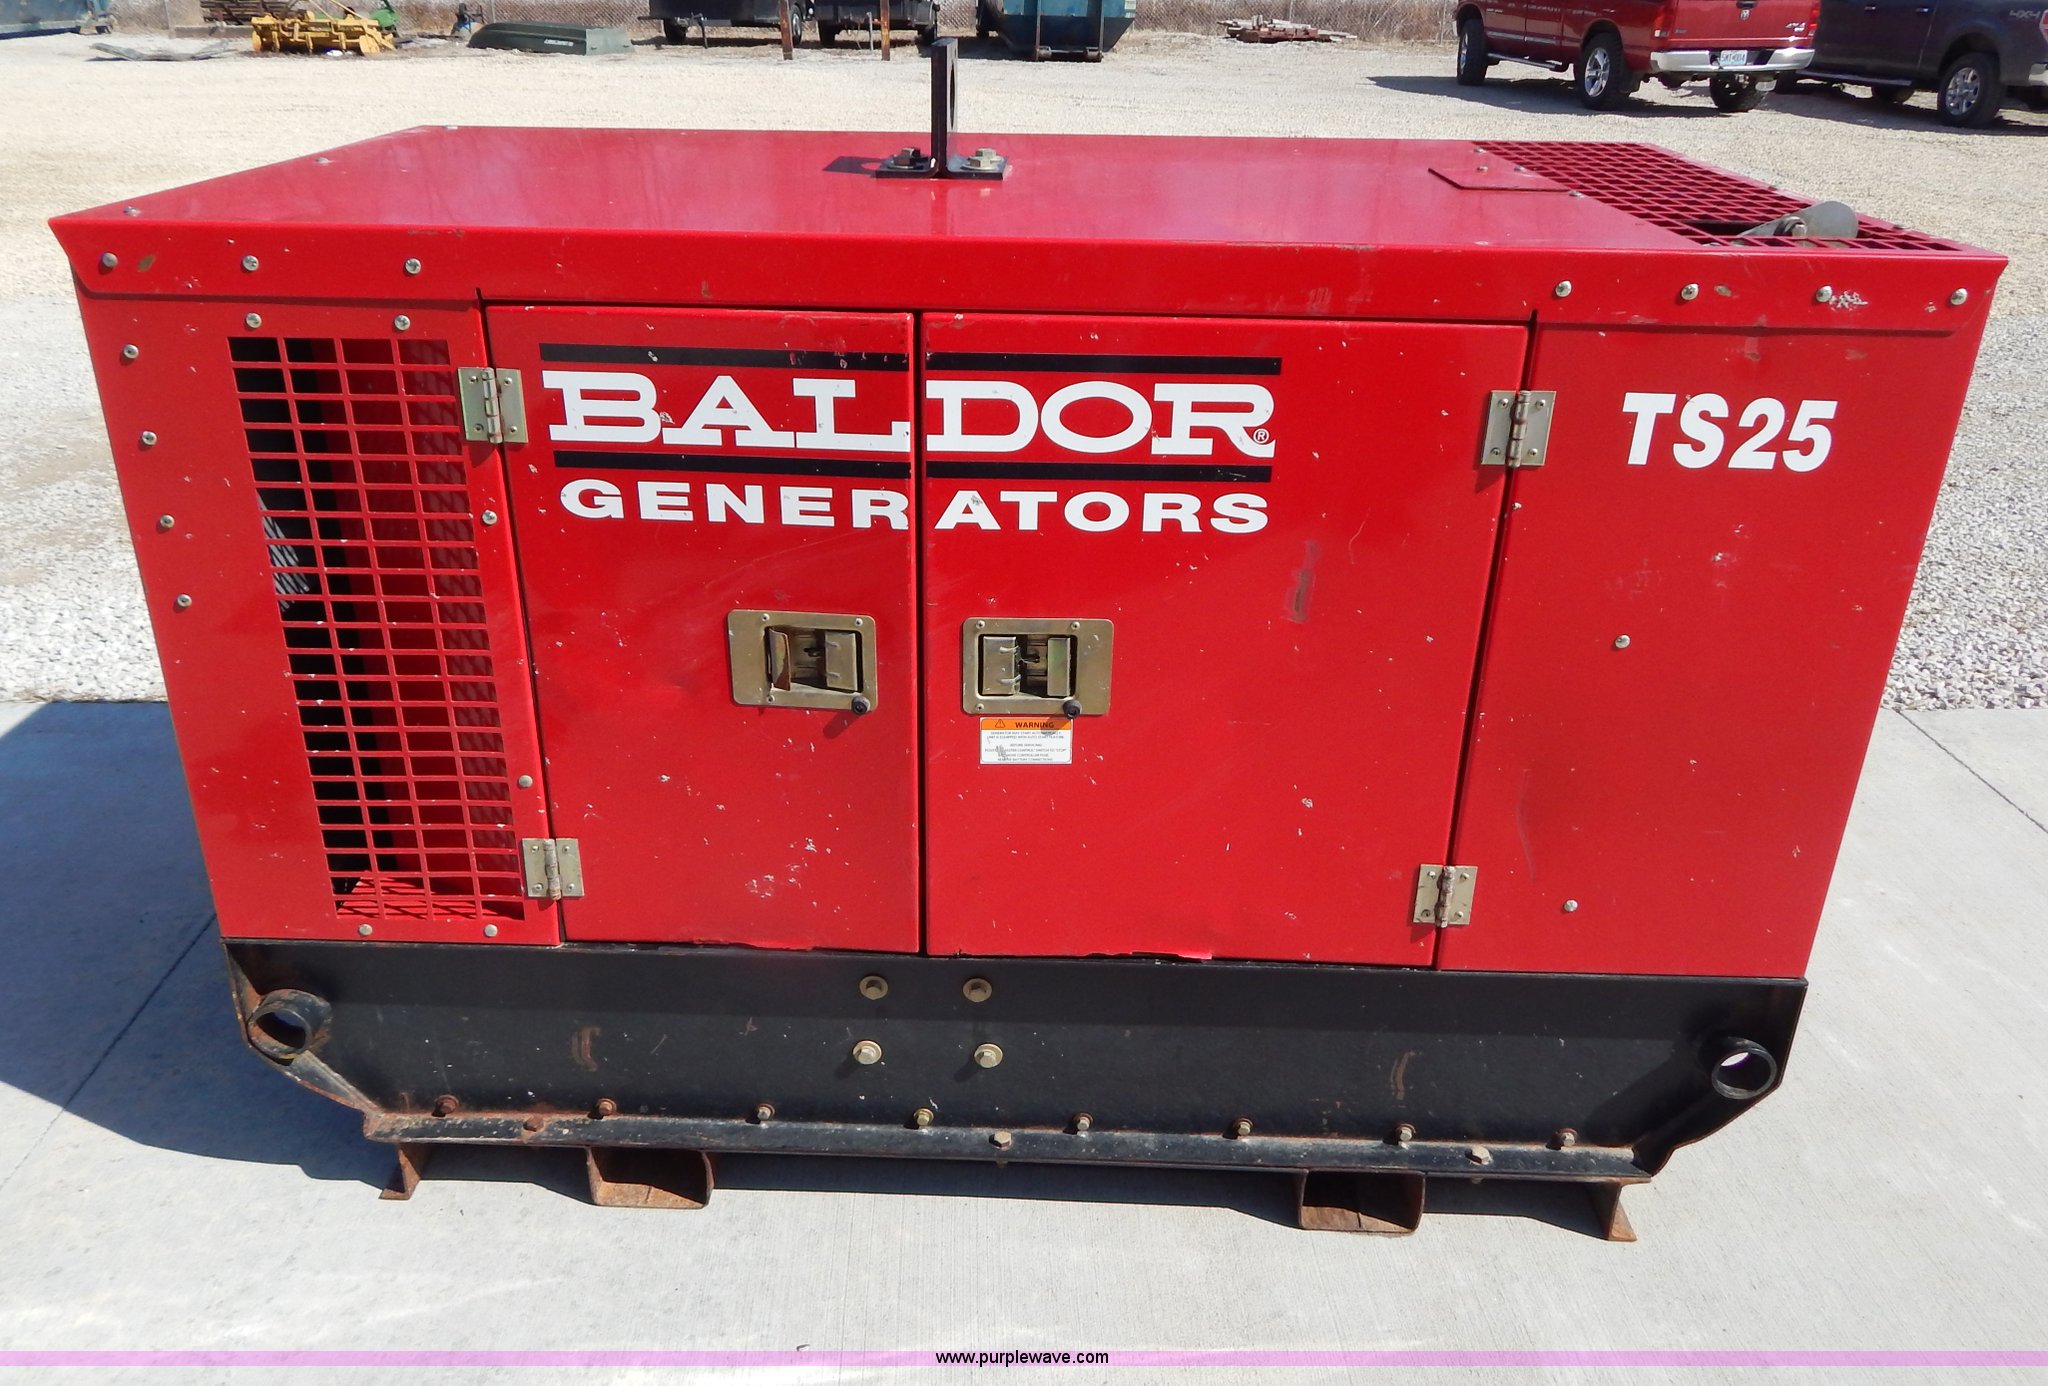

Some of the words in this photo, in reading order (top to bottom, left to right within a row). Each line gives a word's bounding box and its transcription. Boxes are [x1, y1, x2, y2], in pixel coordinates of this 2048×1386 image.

[542, 370, 1276, 458] BALDOR
[1622, 392, 1838, 473] TS25
[560, 478, 1269, 534] GENERATORS
[1015, 721, 1055, 729] WARNING
